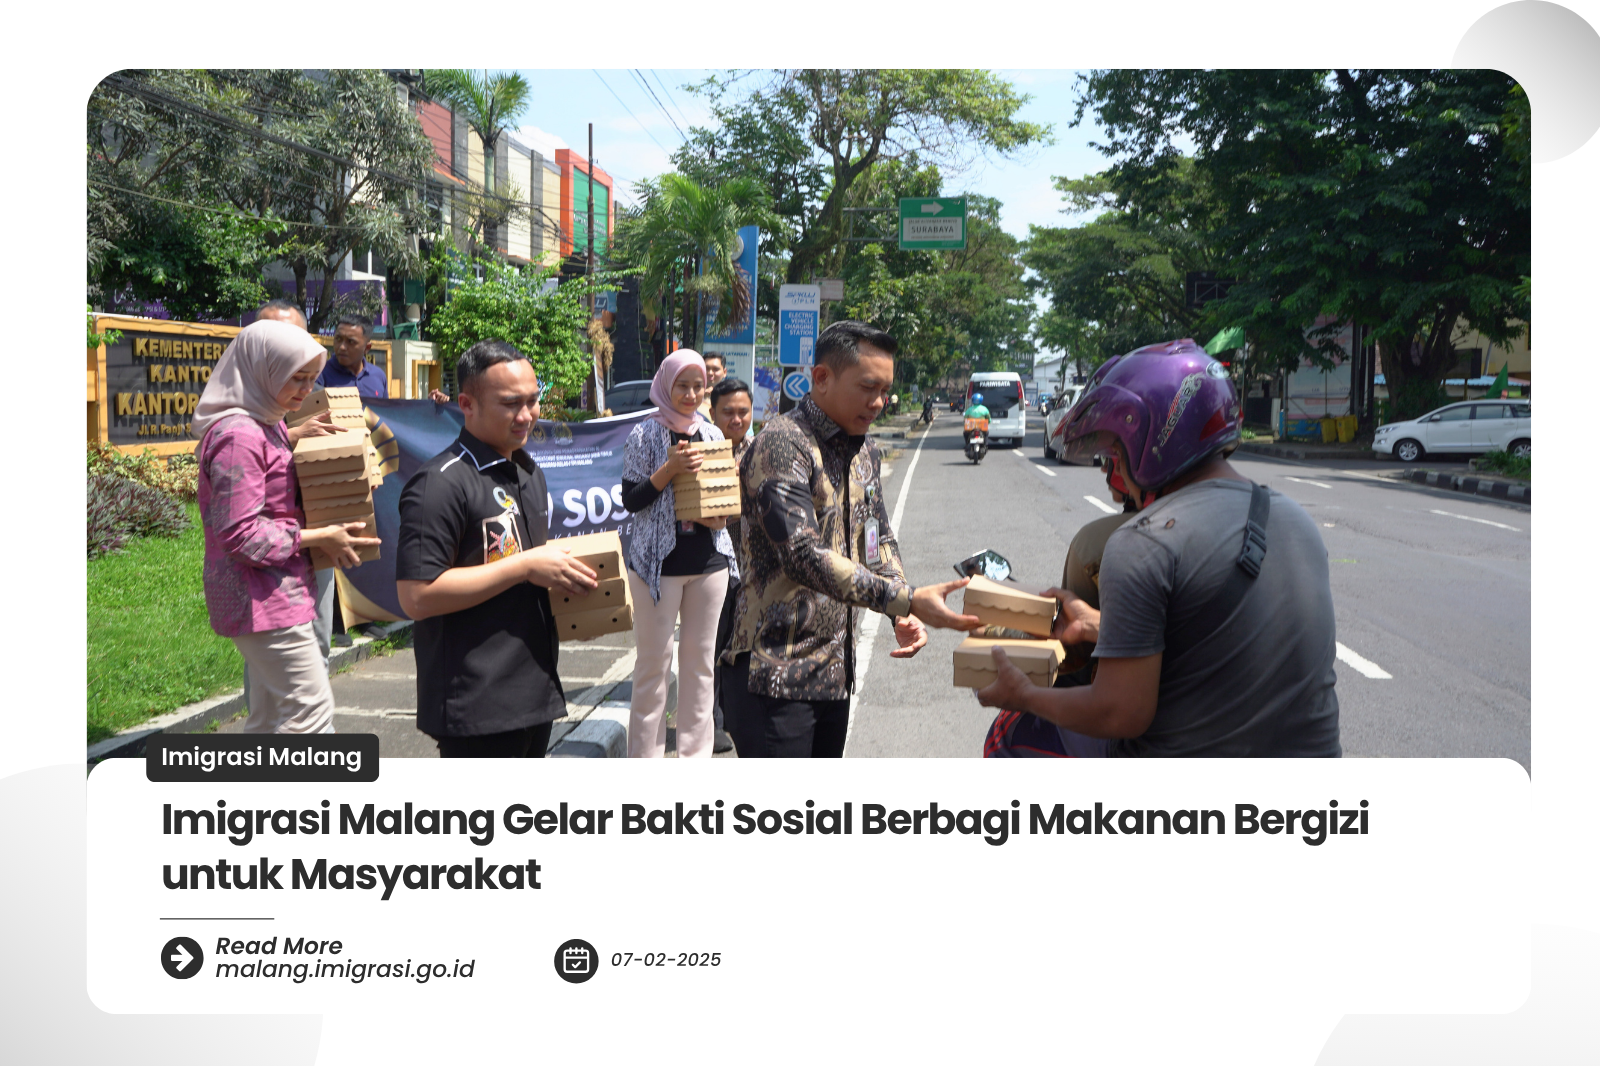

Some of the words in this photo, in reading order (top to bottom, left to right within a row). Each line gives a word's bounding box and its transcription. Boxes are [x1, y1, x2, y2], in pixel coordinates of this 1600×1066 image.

[911, 225, 954, 234] SURABAYA
[134, 337, 228, 360] KEMENTER
[149, 364, 212, 383] KANTO
[562, 483, 634, 528] SOS
